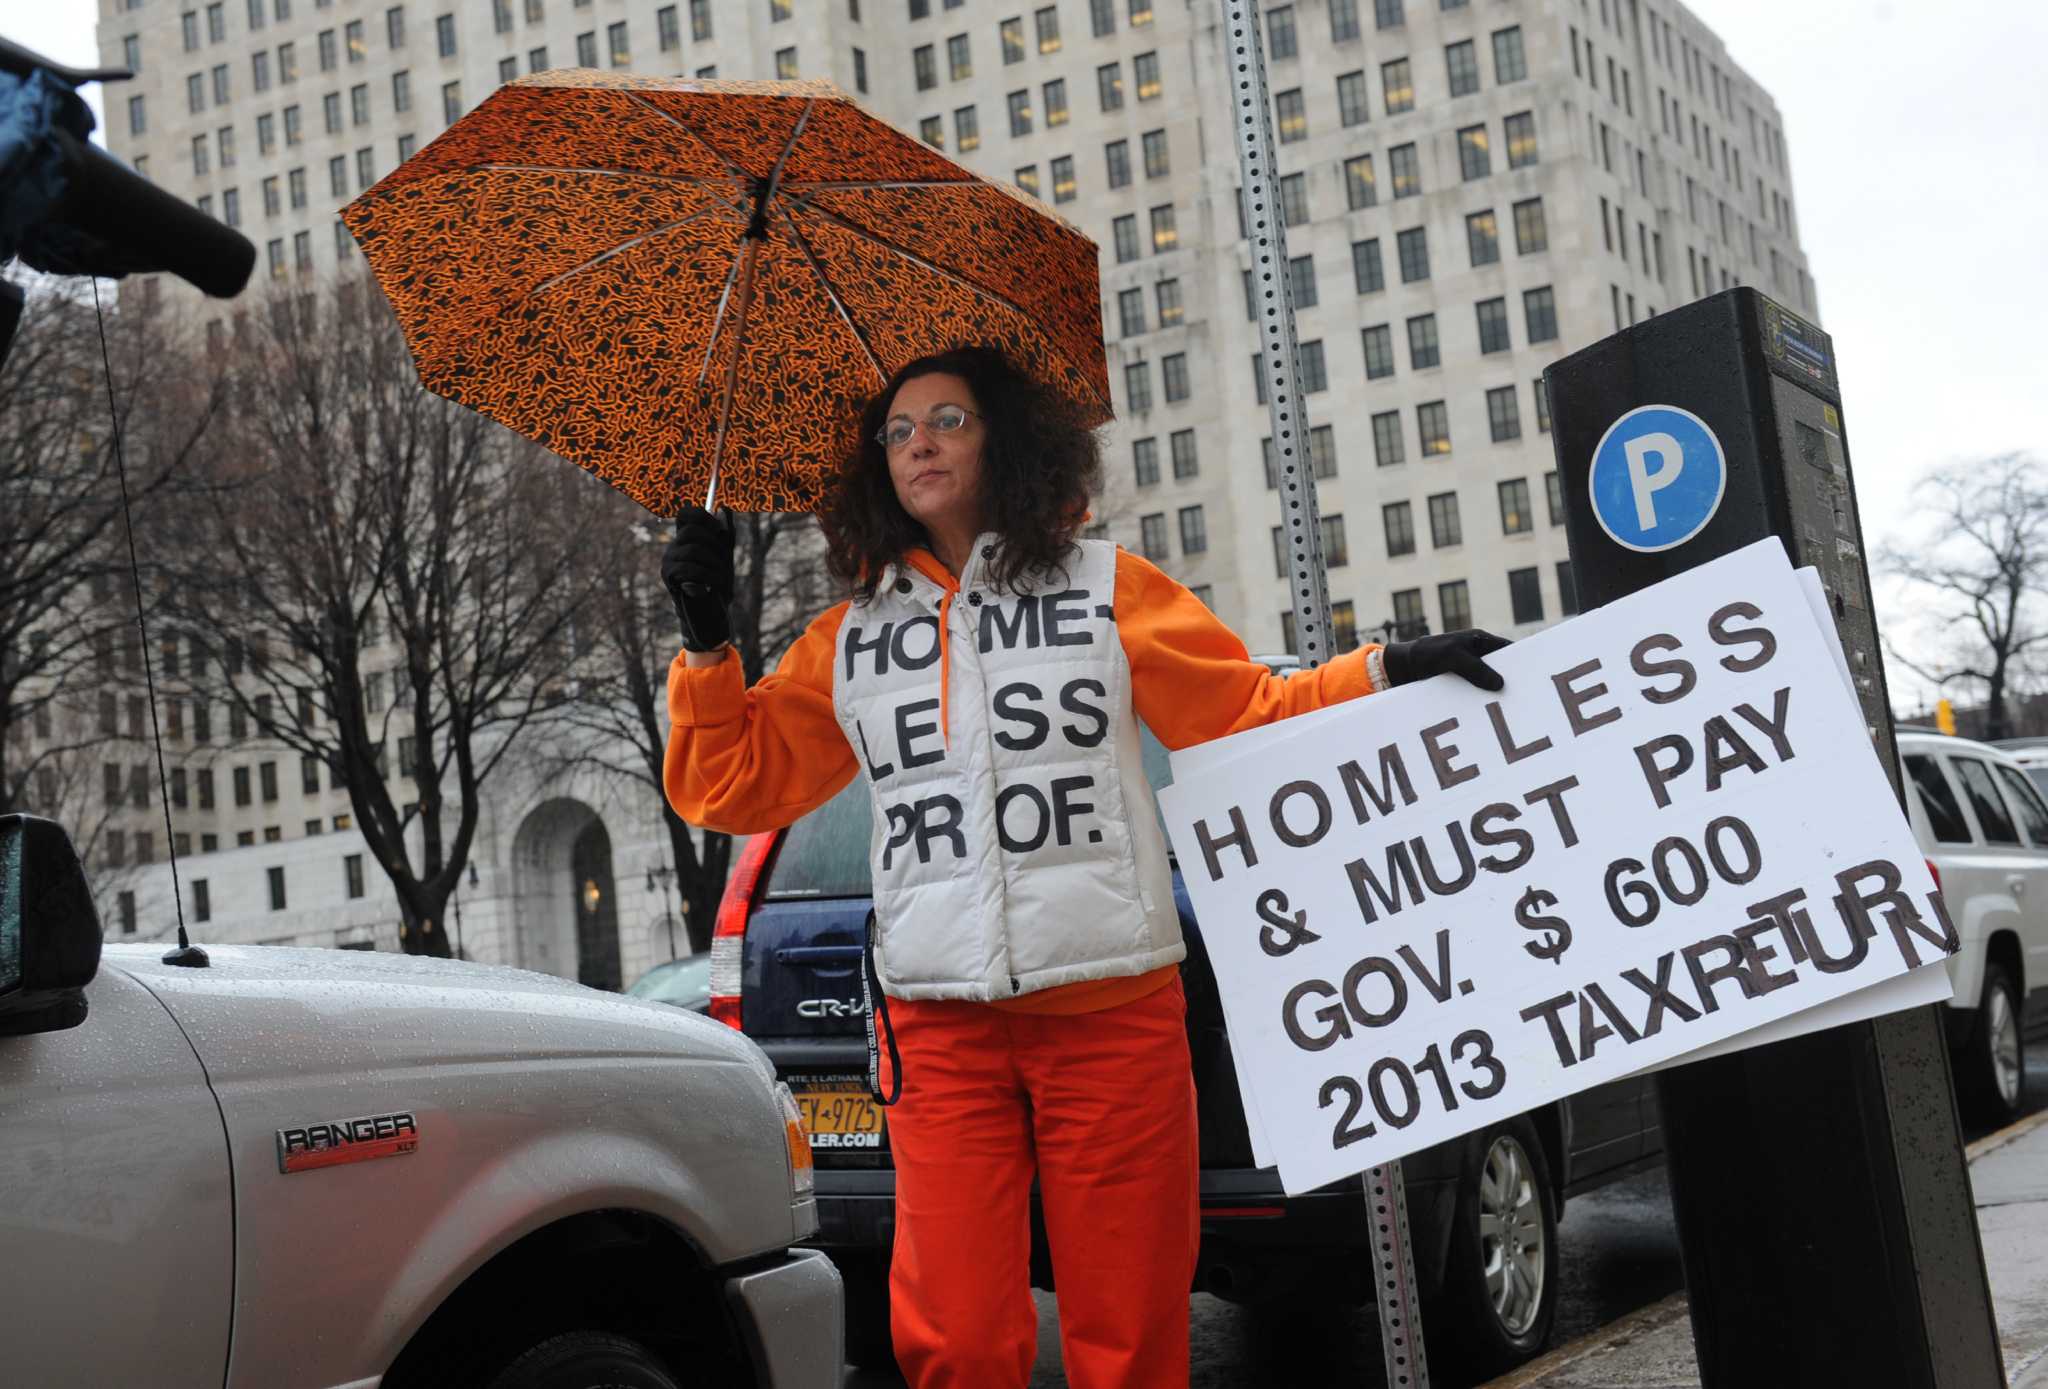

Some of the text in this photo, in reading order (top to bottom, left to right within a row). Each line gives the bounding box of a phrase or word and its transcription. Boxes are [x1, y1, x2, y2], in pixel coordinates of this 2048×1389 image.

[1623, 431, 1684, 532] P
[1192, 601, 1777, 882] HOMELESS
[1256, 686, 1796, 958] & MUST PAY
[1282, 815, 1762, 1052] GOV. $ 600
[284, 1113, 416, 1152] RANGER
[1318, 1029, 1507, 1151] 2013
